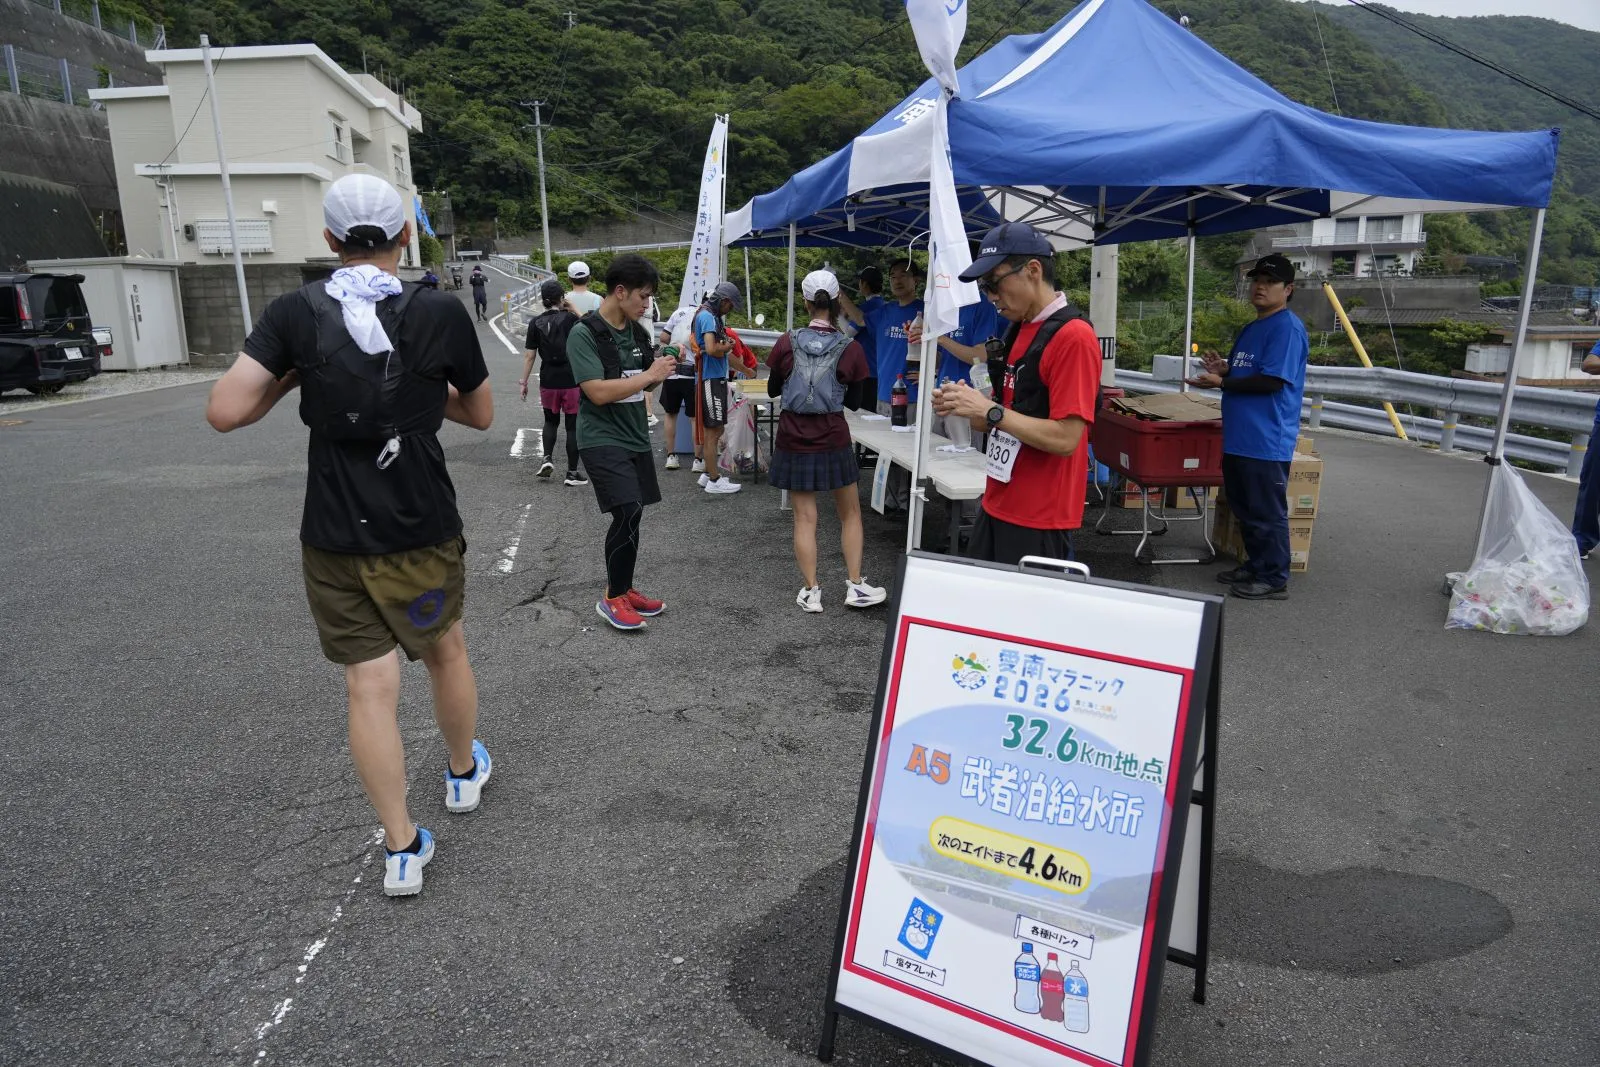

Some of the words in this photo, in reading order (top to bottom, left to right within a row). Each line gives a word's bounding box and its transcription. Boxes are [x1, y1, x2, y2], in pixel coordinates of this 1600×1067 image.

[713, 395, 723, 421] JAPAN
[988, 442, 1010, 465] 330
[997, 649, 1125, 697] 愛南マラニック
[993, 675, 1071, 713] 2026
[903, 743, 952, 784] A5
[960, 755, 1145, 837] 武者泊給水所
[1031, 926, 1079, 948] 各種ドリンク
[896, 957, 937, 978] 塩タブレット
[1070, 981, 1082, 994] 水
